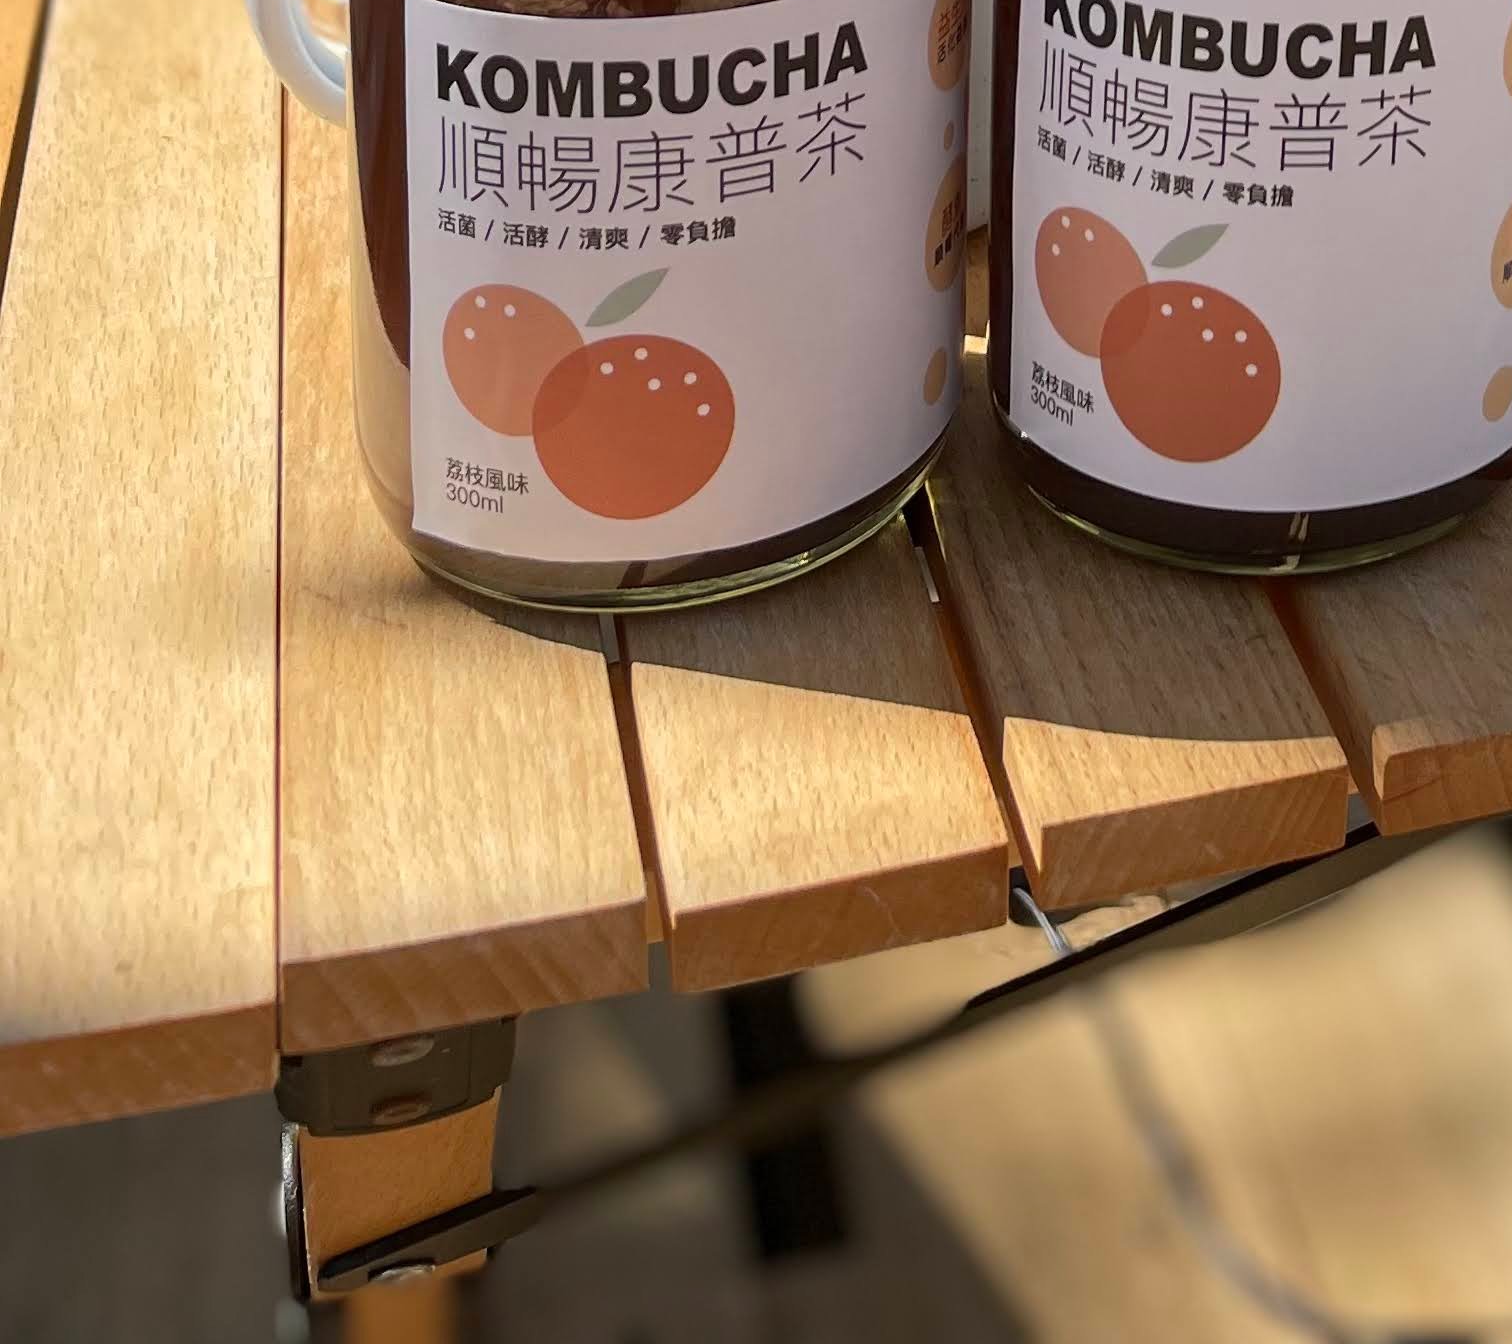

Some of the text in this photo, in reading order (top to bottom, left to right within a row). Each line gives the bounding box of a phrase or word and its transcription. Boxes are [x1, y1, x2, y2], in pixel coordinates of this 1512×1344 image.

[436, 20, 869, 119] KOMBUCHA
[1038, 38, 1433, 172] 順暢康普茶
[438, 92, 868, 213] 順暢康普茶
[1150, 169, 1195, 199] 清爽
[438, 208, 477, 240] 活菌
[503, 221, 549, 249] 活酵
[579, 226, 629, 250] 清爽
[660, 215, 737, 246] 零負擔
[1030, 384, 1074, 427] 300ml
[446, 456, 530, 495] 荔枝風味
[446, 482, 504, 514] 300ml
